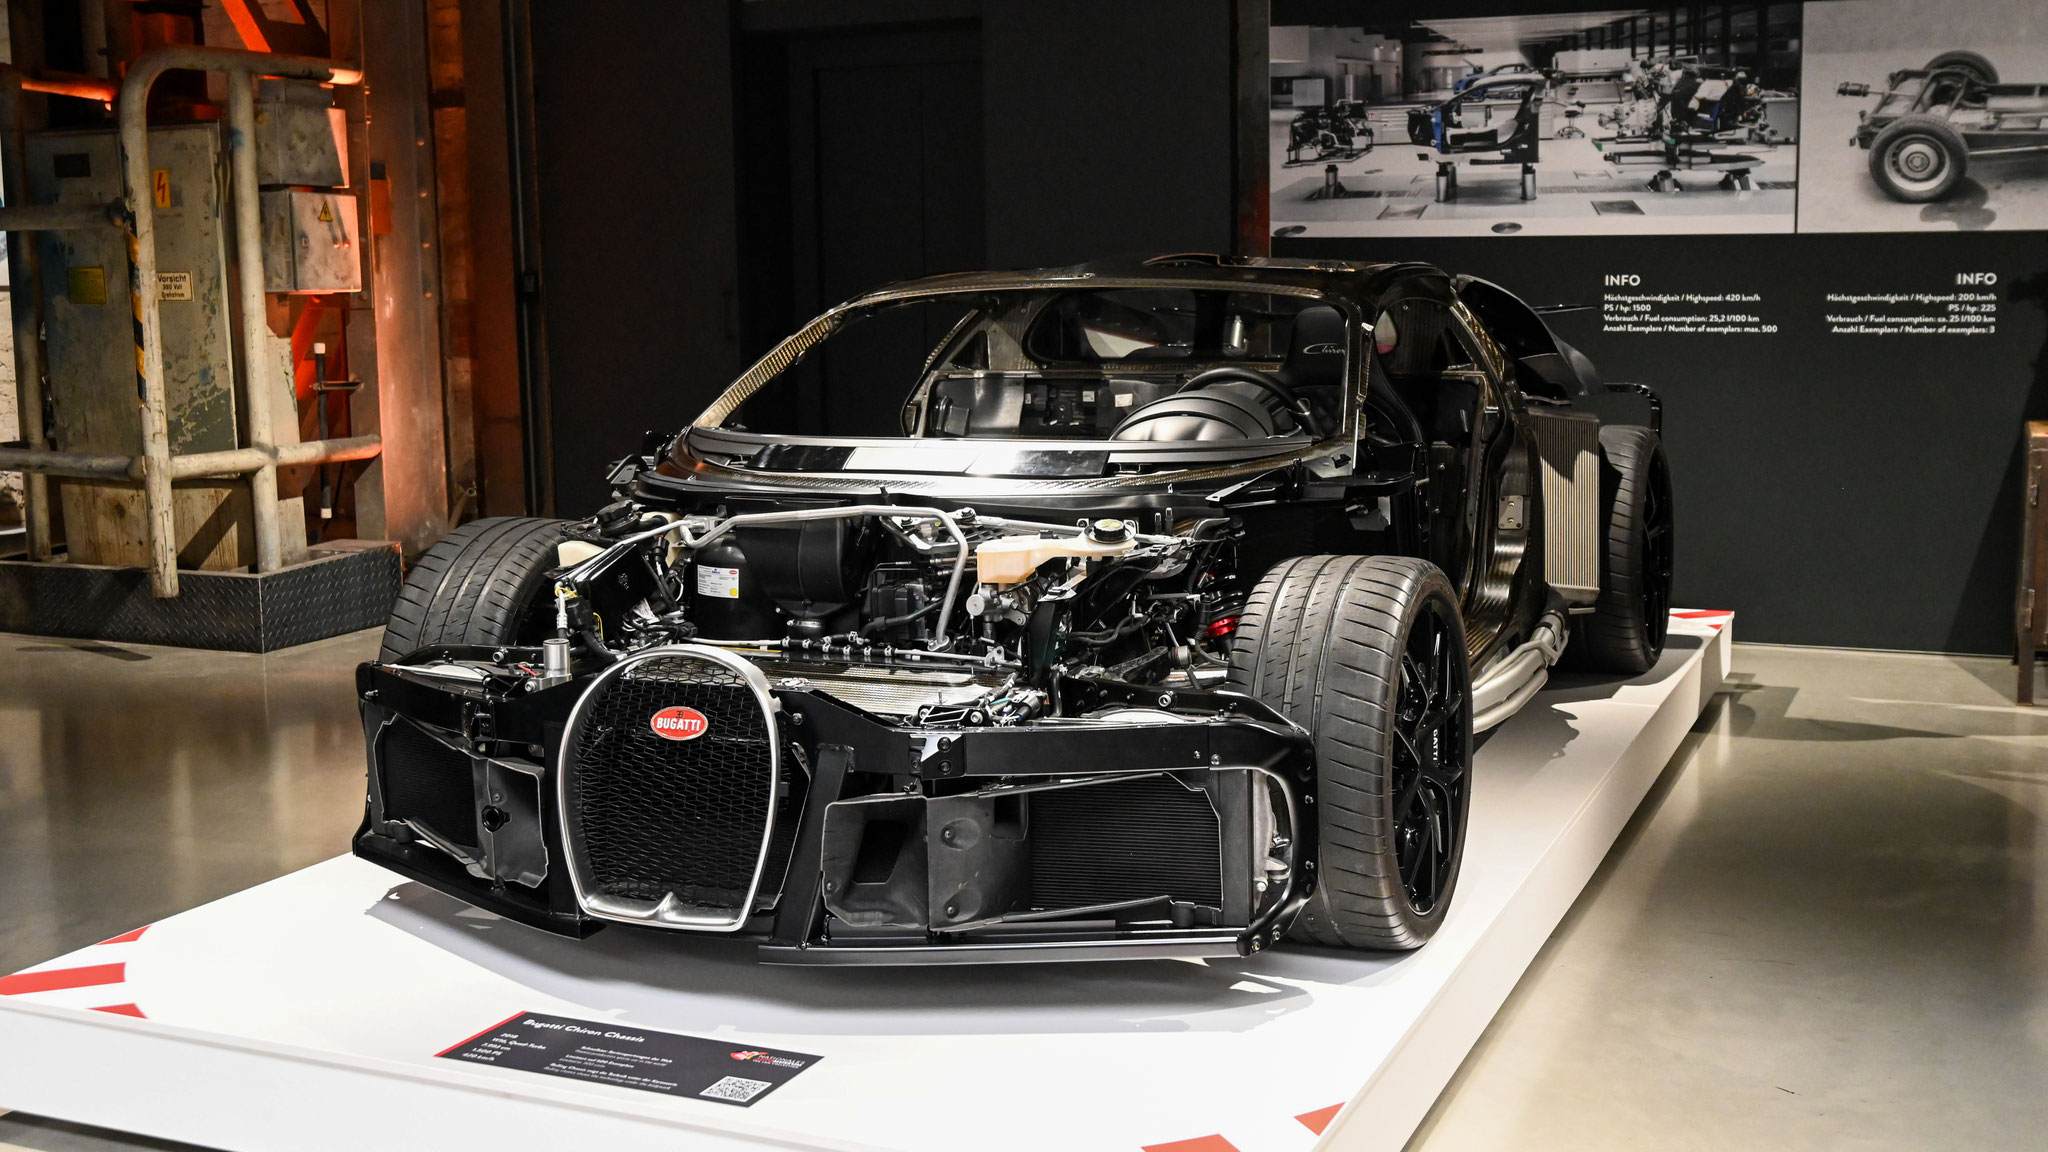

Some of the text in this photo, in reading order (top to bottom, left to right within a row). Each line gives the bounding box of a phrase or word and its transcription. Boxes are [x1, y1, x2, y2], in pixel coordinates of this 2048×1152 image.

[157, 274, 187, 283] Vorsicht
[1604, 274, 1641, 287] INFO
[1956, 272, 1997, 285] INFO
[1604, 293, 1680, 304] Höchstgeschwindigkeit
[1686, 293, 1724, 304] Highspeed:
[1725, 293, 1741, 302] 420
[1742, 293, 1761, 302] km/h
[1827, 293, 1909, 304] Höchstgeschwindigkeit
[1916, 293, 1956, 304] Highspeed:
[1958, 293, 1975, 301] 200
[1976, 293, 1997, 301] km/h
[1604, 304, 1614, 312] PS
[1620, 304, 1631, 314] hp:
[1632, 304, 1652, 312] 1500
[1948, 304, 1960, 312] PS
[1966, 304, 1979, 314] hp:
[1980, 304, 1996, 312] 225
[1603, 314, 1639, 323] Verbrauch
[1644, 314, 1660, 323] Fuel
[1661, 314, 1708, 324] consumption:
[1709, 315, 1726, 324] 25,2
[1747, 314, 1760, 323] km
[1826, 315, 1863, 323] Verbrauch
[1869, 315, 1886, 323] Fuel
[1886, 315, 1936, 325] consumption:
[1949, 315, 1960, 323] 25
[1983, 315, 1996, 323] km
[1627, 325, 1663, 334] Exemplare
[1668, 325, 1697, 333] Number
[1697, 325, 1706, 333] of
[1706, 325, 1743, 334] exemplars:
[1761, 325, 1778, 333] 500
[1832, 325, 1859, 333] Anzahl
[1859, 325, 1898, 335] Exemplare
[1905, 326, 1937, 334] Number
[1937, 326, 1946, 334] of
[1947, 326, 1988, 335] exemplars:
[656, 717, 701, 731] BUGATTI
[523, 1018, 645, 1043] Bugatti Chiron Chassis
